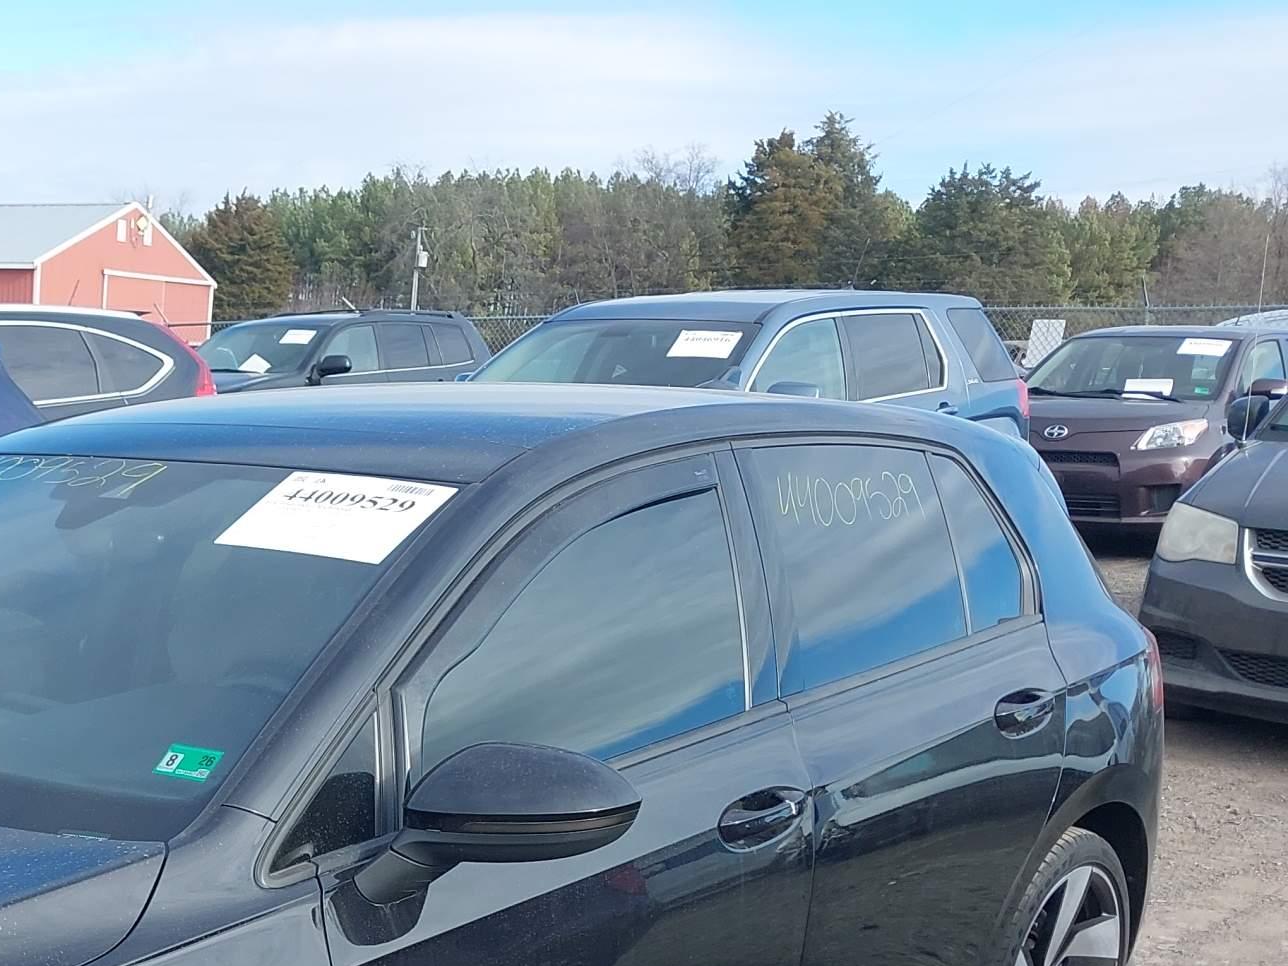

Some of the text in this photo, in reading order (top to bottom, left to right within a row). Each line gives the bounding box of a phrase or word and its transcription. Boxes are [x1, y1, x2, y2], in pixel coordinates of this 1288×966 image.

[284, 488, 417, 514] 44009529
[776, 471, 926, 526] 44009529
[165, 754, 216, 767] 8 26
